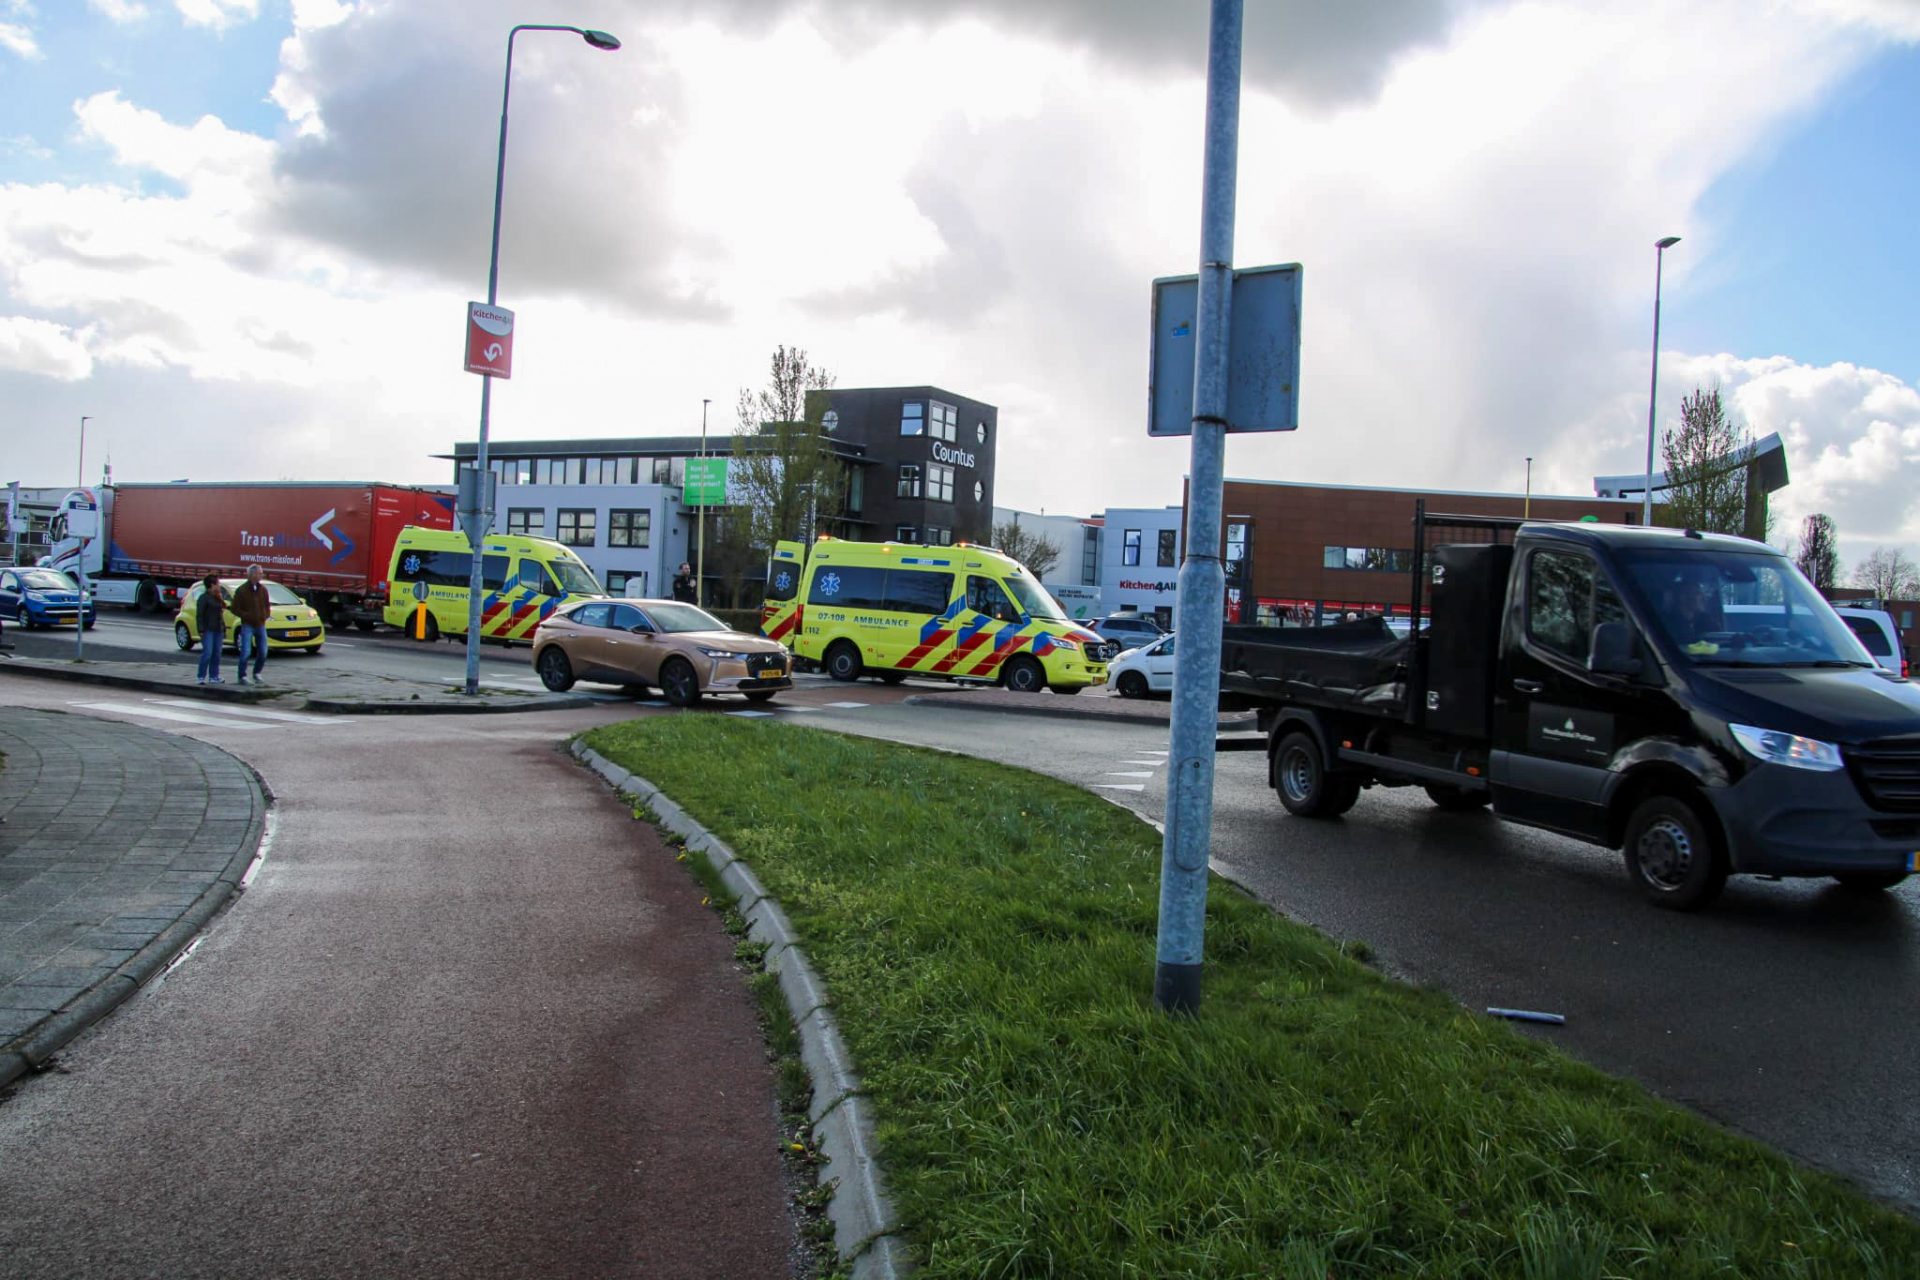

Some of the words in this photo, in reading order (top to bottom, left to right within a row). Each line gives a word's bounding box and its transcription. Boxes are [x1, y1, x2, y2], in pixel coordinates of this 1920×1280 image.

[932, 441, 975, 468] Countus
[240, 553, 303, 566] www.trans-mission.nl
[1119, 580, 1177, 594] Kitchen4All
[430, 591, 470, 599] AMBULANC
[818, 612, 846, 622] 07-108
[853, 615, 910, 627] AMBULANCE
[809, 626, 820, 634] 112
